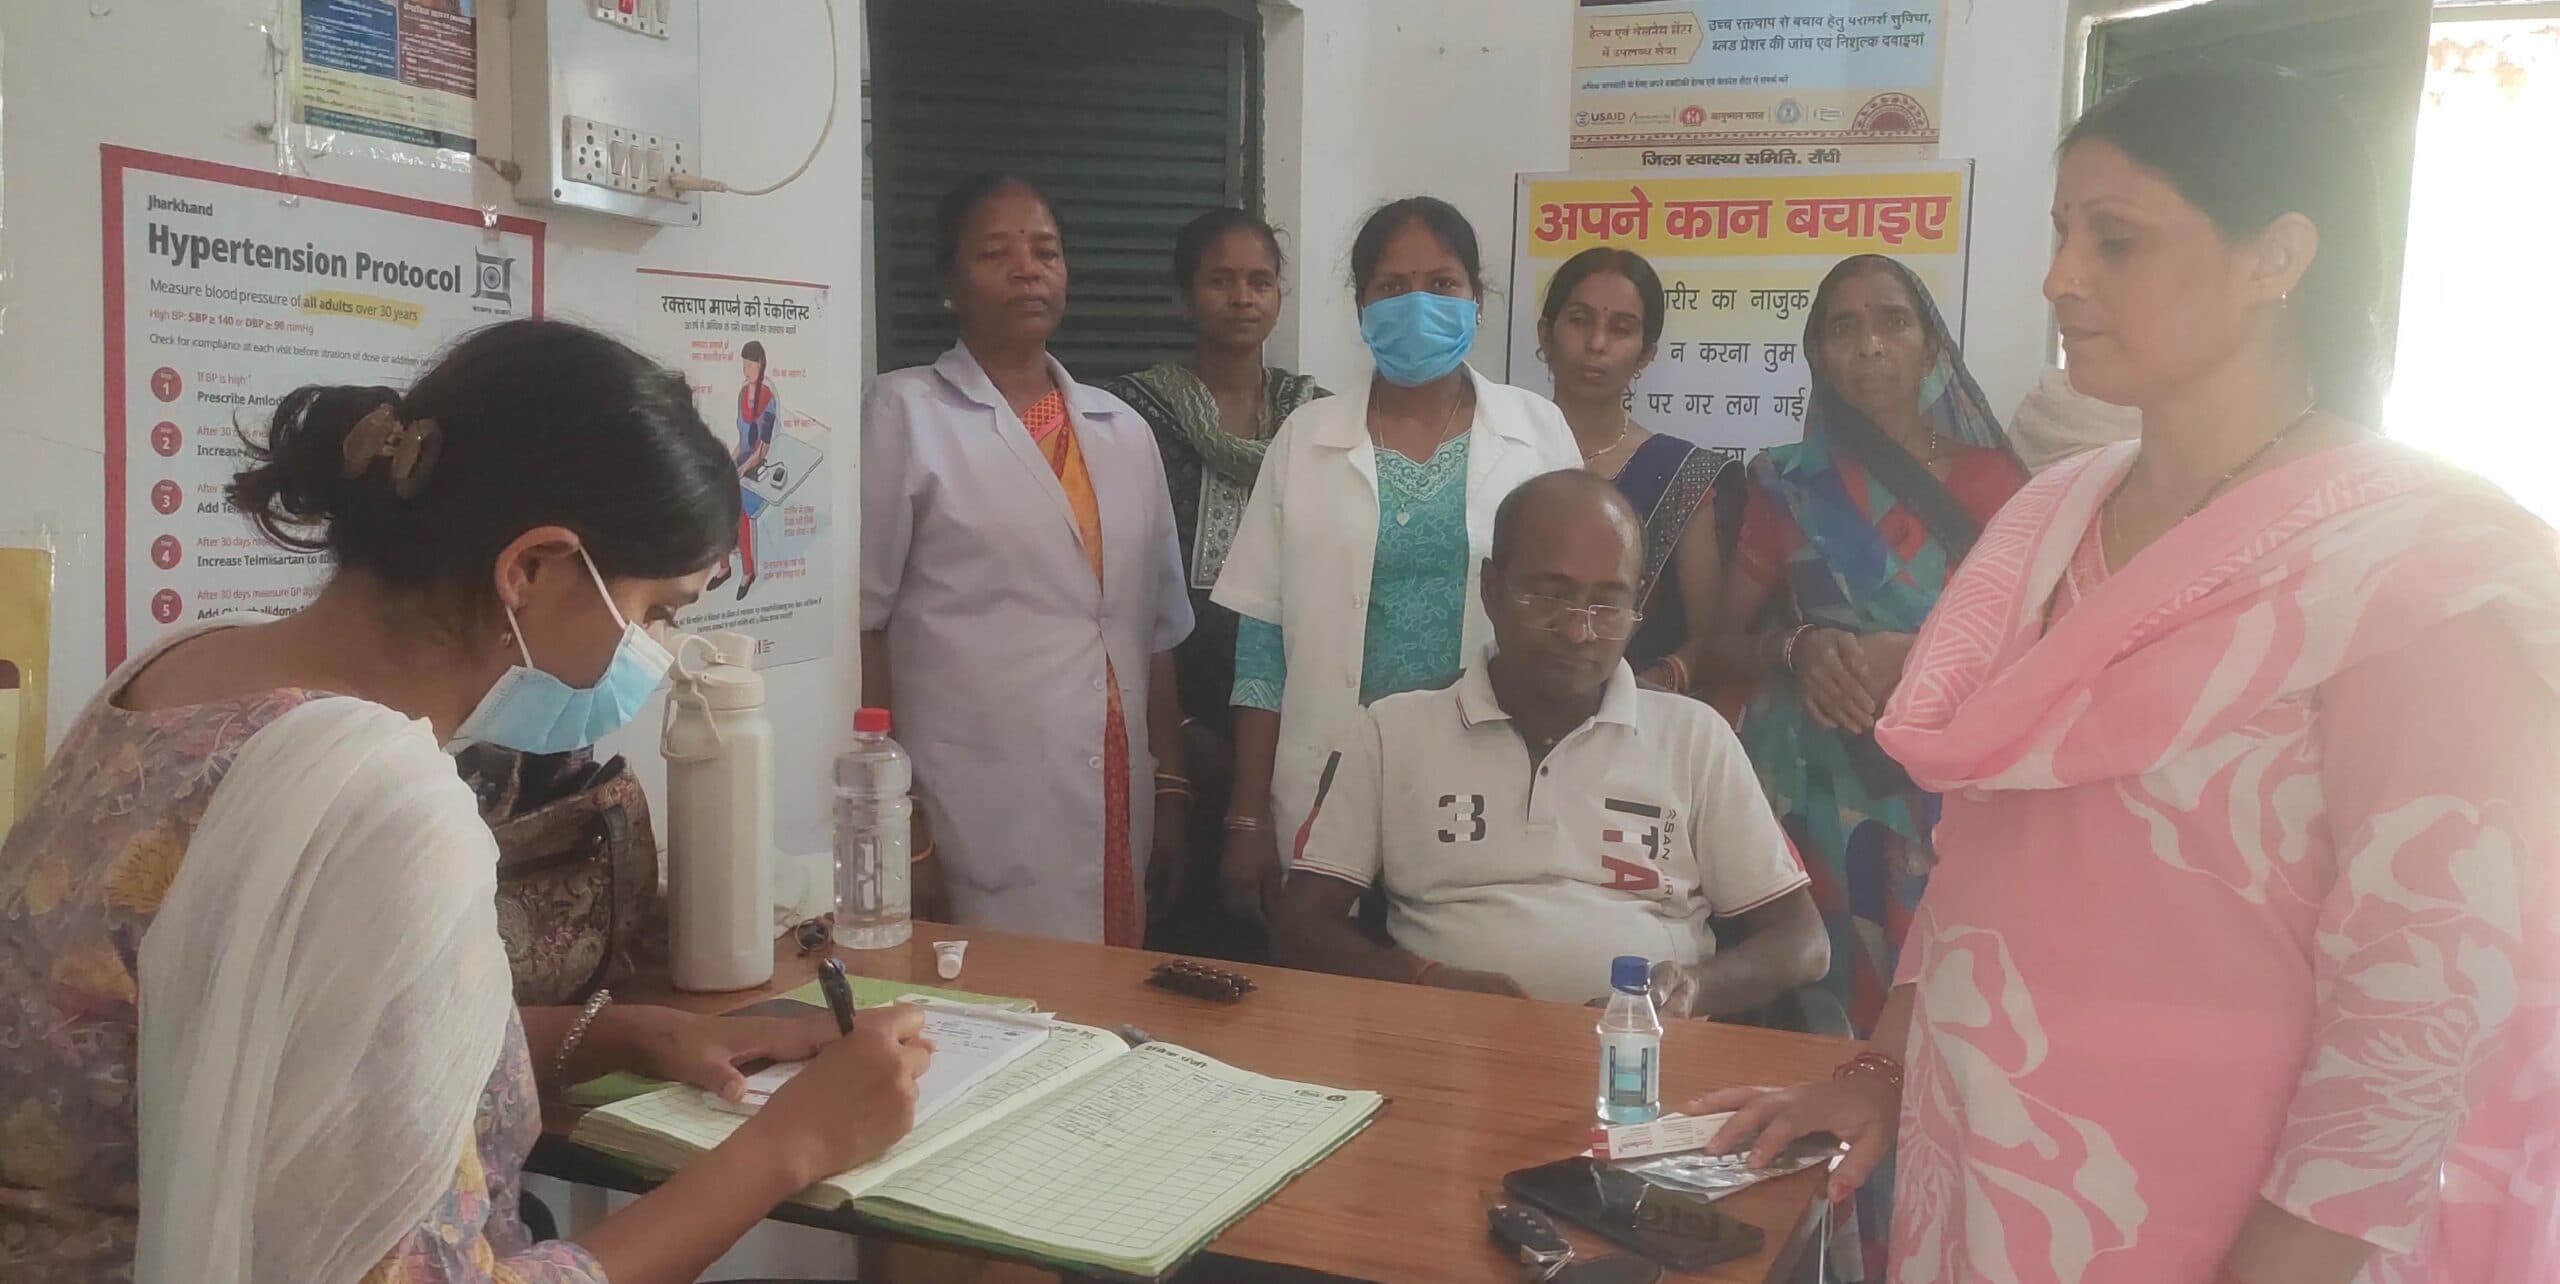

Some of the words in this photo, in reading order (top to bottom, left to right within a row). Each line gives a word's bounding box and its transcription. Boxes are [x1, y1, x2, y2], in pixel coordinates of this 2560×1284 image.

[1735, 17, 1776, 31] रक्तचाप
[1792, 16, 1823, 28] बचाव
[1827, 14, 1845, 32] हेतु
[1848, 11, 1887, 26] परामर्श
[1712, 39, 1737, 51] ब्लड
[1740, 36, 1766, 51] प्रेशर
[1769, 35, 1785, 50] की
[1816, 36, 1833, 50] एवं
[1835, 34, 1878, 52] निशुल्क
[1591, 111, 1625, 122] USAID
[1642, 150, 1682, 166] जिला
[1686, 151, 1740, 166] स्वास्थ्य
[147, 195, 213, 216] Jharkhand
[1534, 186, 1653, 242] अपने
[1664, 200, 1773, 240] कान
[1785, 195, 1952, 245] बचाइए
[149, 222, 347, 278] Hypertension
[355, 251, 460, 293] Protocol
[150, 277, 201, 296] Measure
[205, 284, 237, 301] blood
[239, 290, 288, 306] pressure
[290, 294, 302, 306] of
[303, 296, 317, 309] all
[319, 298, 353, 313] adults
[356, 305, 377, 317] over
[381, 304, 391, 317] 30
[393, 308, 418, 322] years
[661, 295, 707, 315] रक्तचाप
[709, 293, 741, 317] मापने
[744, 296, 761, 318] की
[764, 297, 810, 320] चेकलिस्ट
[1664, 281, 1700, 310] रीर
[1712, 289, 1737, 310] का
[1750, 289, 1810, 320] नाजुक
[150, 309, 169, 323] High
[188, 312, 207, 323] SBP
[219, 314, 234, 326] 140
[245, 317, 264, 328] DBP
[150, 333, 174, 345] Check
[177, 335, 190, 346] for
[1670, 342, 1687, 362] न
[1699, 342, 1751, 364] करना
[1763, 343, 1798, 373] तुम
[162, 382, 170, 395] 1
[1648, 393, 1674, 414] पर
[1685, 394, 1714, 415] गर
[1725, 395, 1760, 415] लग
[1774, 387, 1806, 422] गई
[162, 437, 170, 450] 2
[162, 495, 170, 508] 3
[197, 502, 219, 513] Add
[162, 549, 170, 562] 4
[197, 556, 242, 568] Increase
[244, 555, 304, 567] Telmisartan
[162, 603, 170, 617] 5
[1438, 794, 1486, 842] 3
